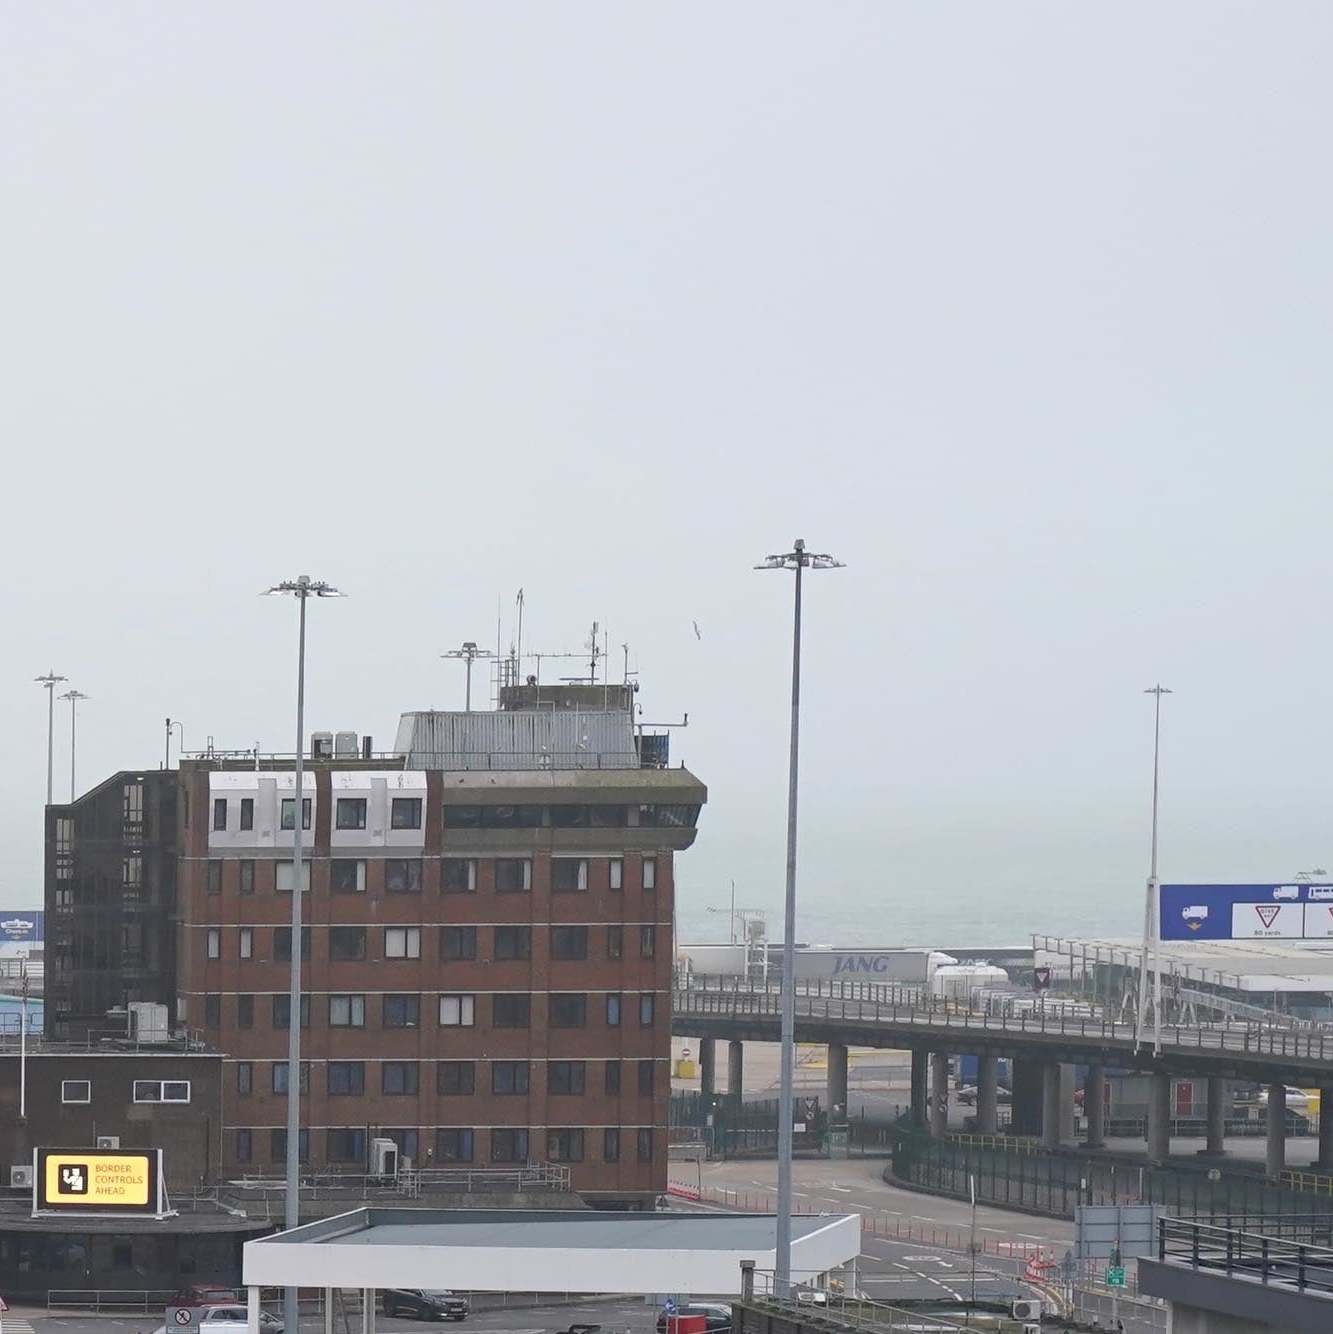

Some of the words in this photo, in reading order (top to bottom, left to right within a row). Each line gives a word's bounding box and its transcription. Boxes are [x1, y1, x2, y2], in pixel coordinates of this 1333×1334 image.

[833, 956, 890, 975] JANG
[95, 1165, 131, 1173] BORDER
[95, 1176, 143, 1184] CONTROLS
[95, 1187, 125, 1195] AHEAD
